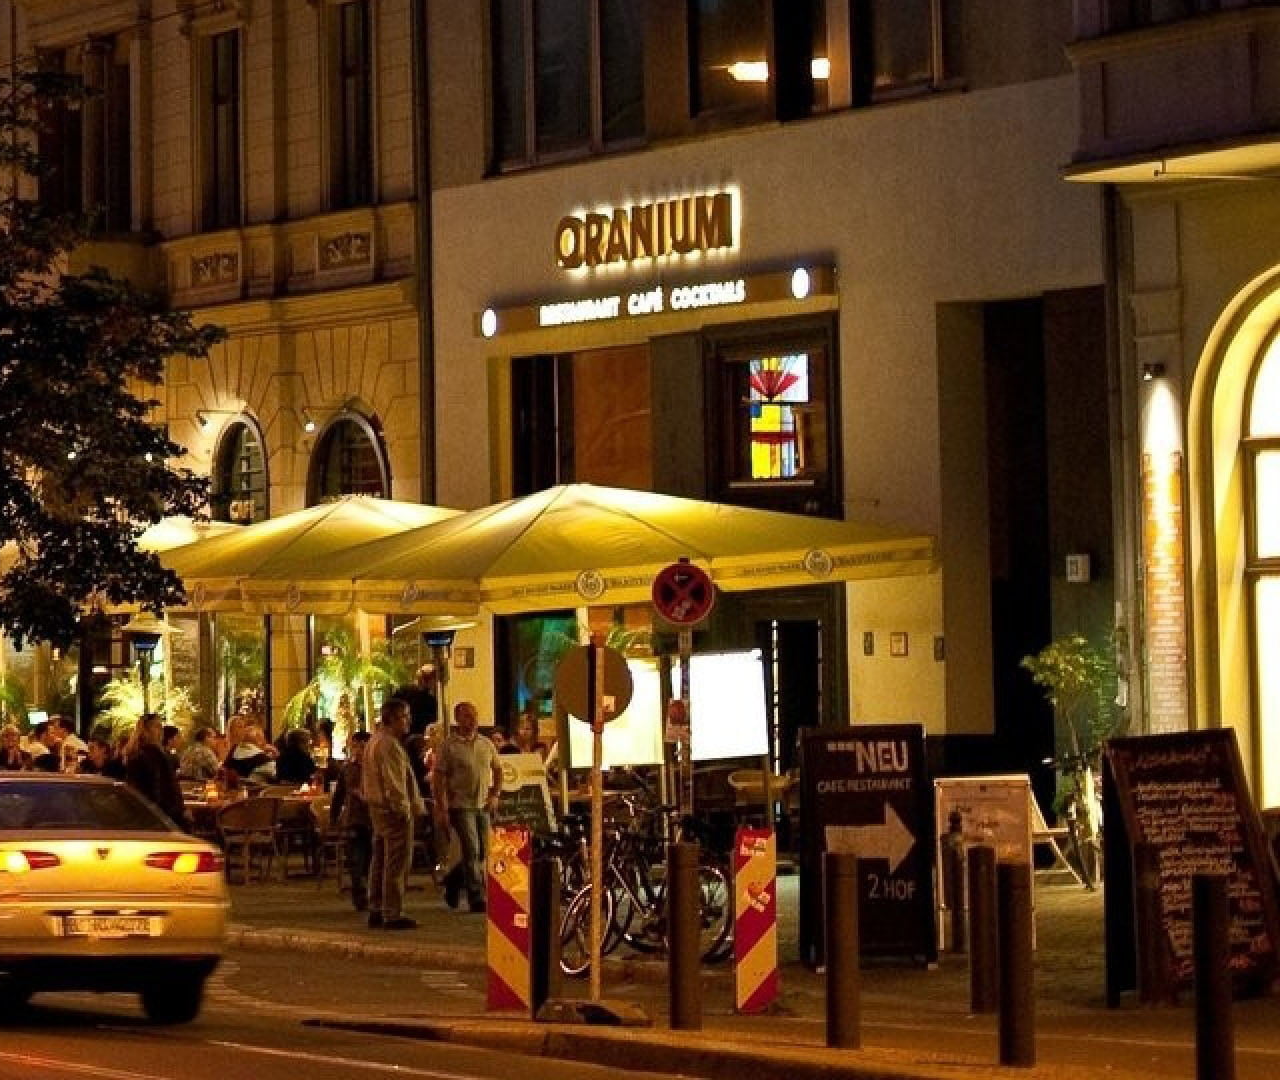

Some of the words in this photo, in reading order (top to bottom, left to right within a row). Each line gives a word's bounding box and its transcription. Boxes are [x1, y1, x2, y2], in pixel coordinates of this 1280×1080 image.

[555, 192, 735, 269] ORANIUM
[855, 741, 909, 773] NEU
[883, 878, 917, 901] HOF
